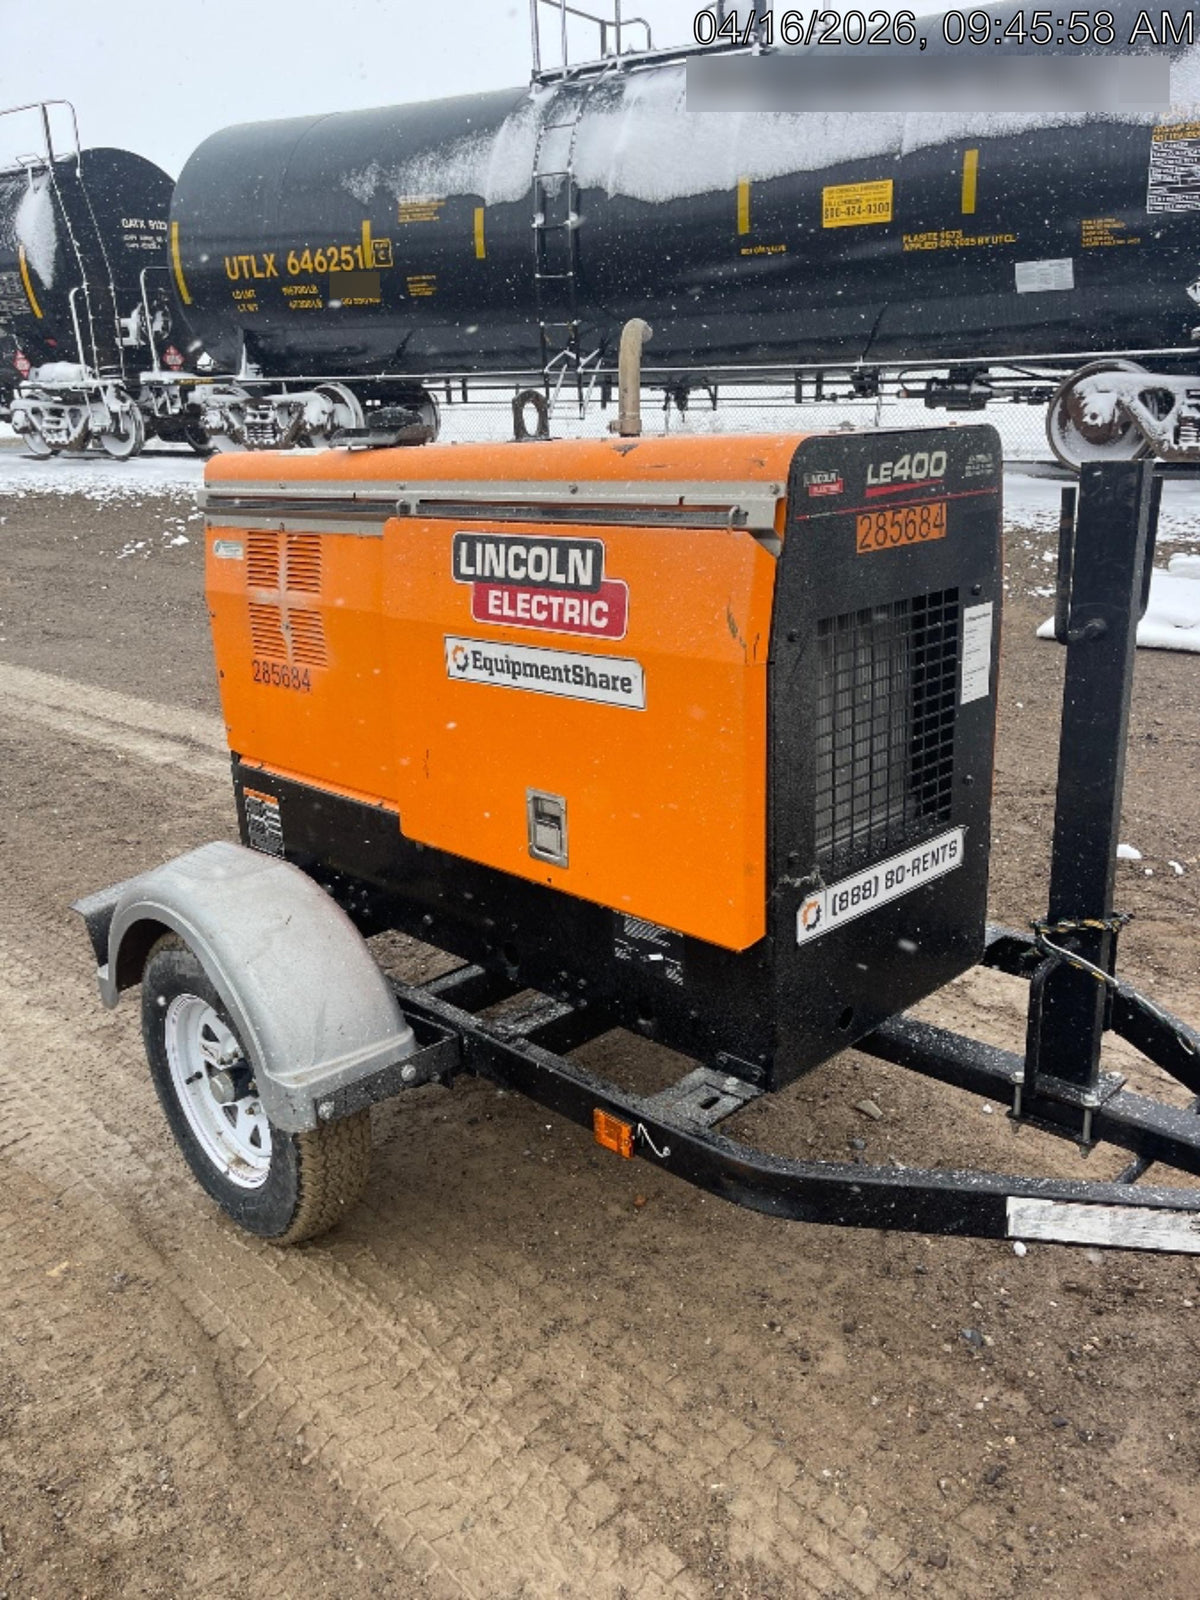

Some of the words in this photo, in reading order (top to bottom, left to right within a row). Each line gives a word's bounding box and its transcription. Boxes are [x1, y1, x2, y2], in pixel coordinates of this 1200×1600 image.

[224, 253, 279, 280] UTLX
[287, 245, 364, 275] 646251
[866, 450, 948, 485] LE400
[859, 502, 945, 550] 285684
[459, 541, 593, 586] LINCOLN
[488, 589, 609, 628] ELECTRIC
[252, 659, 312, 692] 285684
[470, 650, 633, 694] EquipmentShare
[831, 875, 879, 916] (888)
[885, 839, 958, 890] 80-RENTS
